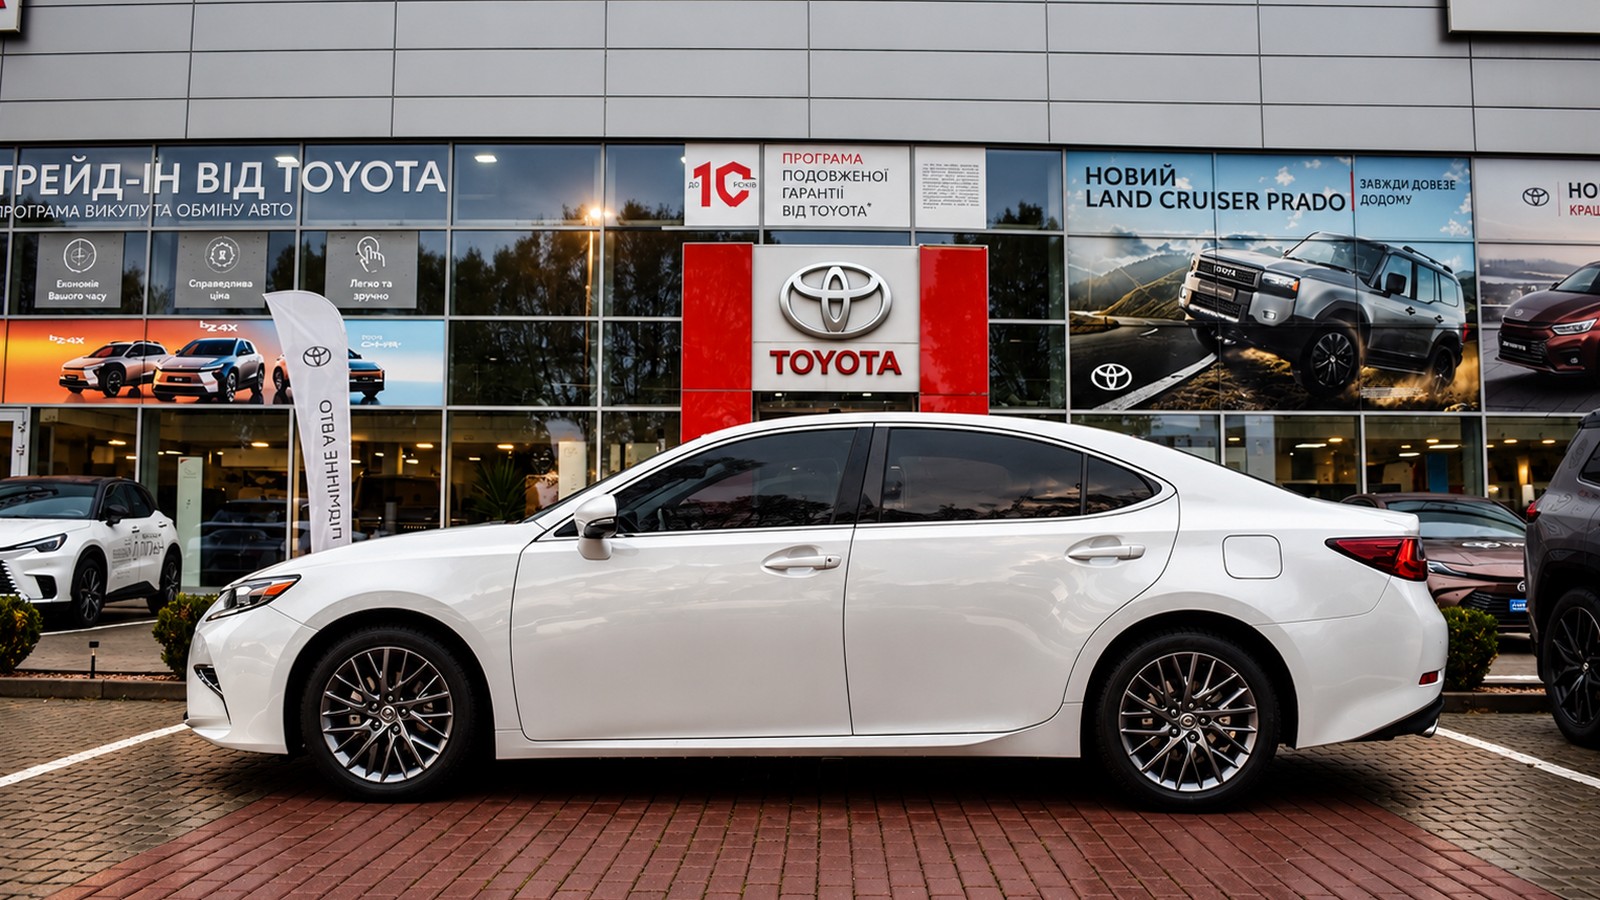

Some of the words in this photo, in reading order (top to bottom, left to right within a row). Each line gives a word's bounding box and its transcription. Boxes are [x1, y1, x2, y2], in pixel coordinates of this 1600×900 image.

[782, 152, 864, 165] ПРОГРАМА
[196, 161, 265, 200] ВІД
[277, 160, 447, 193] TOYOTA
[782, 167, 889, 183] ПОДОВЖЕНОЇ
[1085, 163, 1176, 187] НОВИЙ
[782, 185, 844, 199] ГАРАНТІЇ
[1360, 178, 1410, 191] ЗАВЖДИ
[1411, 179, 1456, 192] ДОВЕЗЕ
[1568, 182, 1600, 199] НО
[1086, 189, 1152, 208] LAND
[1159, 190, 1260, 210] CRUISER
[1267, 192, 1346, 212] PRADO
[1360, 194, 1412, 207] ДОДОМУ
[85, 203, 150, 218] ВИКУПУ
[153, 203, 173, 217] ТА
[176, 203, 244, 217] ОБМІНУ
[248, 202, 293, 217] АВТО
[782, 205, 806, 219] ВІД
[56, 279, 99, 289] Економія
[188, 279, 253, 290] Справедлива
[350, 279, 380, 289] Легко
[381, 280, 393, 288] та
[48, 291, 84, 301] Вашого
[85, 293, 107, 302] часу
[209, 291, 230, 301] ціна
[353, 293, 390, 302] зручно
[769, 349, 902, 376] TOYOTA
